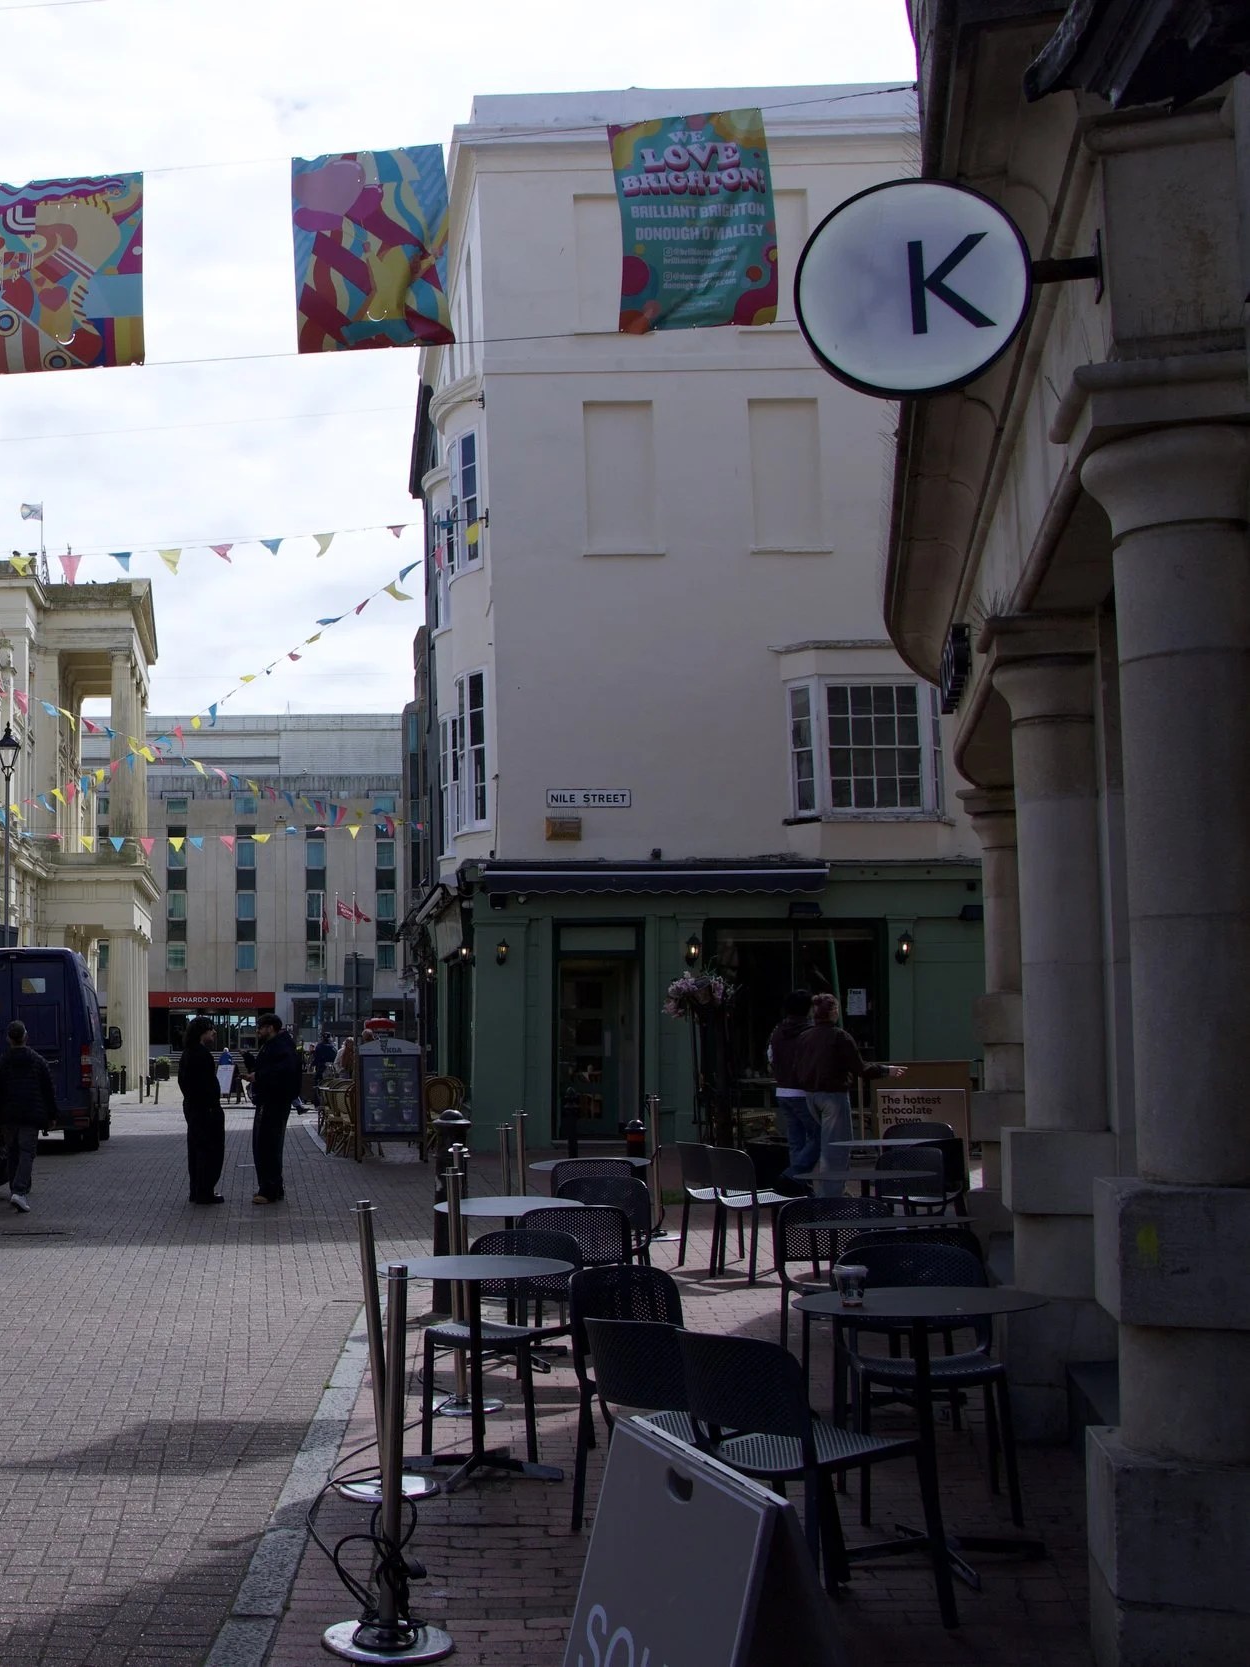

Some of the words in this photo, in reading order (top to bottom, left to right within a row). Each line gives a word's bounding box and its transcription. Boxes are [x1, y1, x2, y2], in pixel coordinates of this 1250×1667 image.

[668, 131, 705, 143] WE
[640, 142, 740, 173] LOVE
[622, 167, 766, 197] BRIGHTON!
[630, 204, 697, 218] BRILLIANT
[699, 202, 765, 218] BRIGHTON
[635, 226, 700, 241] DONOUGH
[701, 223, 764, 241] O'MALLEY
[907, 232, 997, 334] K
[550, 794, 576, 803] NILE
[583, 794, 627, 803] STREET
[881, 1095, 900, 1104] The
[903, 1094, 942, 1104] hottest
[882, 1105, 933, 1115] chocolate
[882, 1115, 892, 1125] in
[895, 1116, 922, 1124] town
